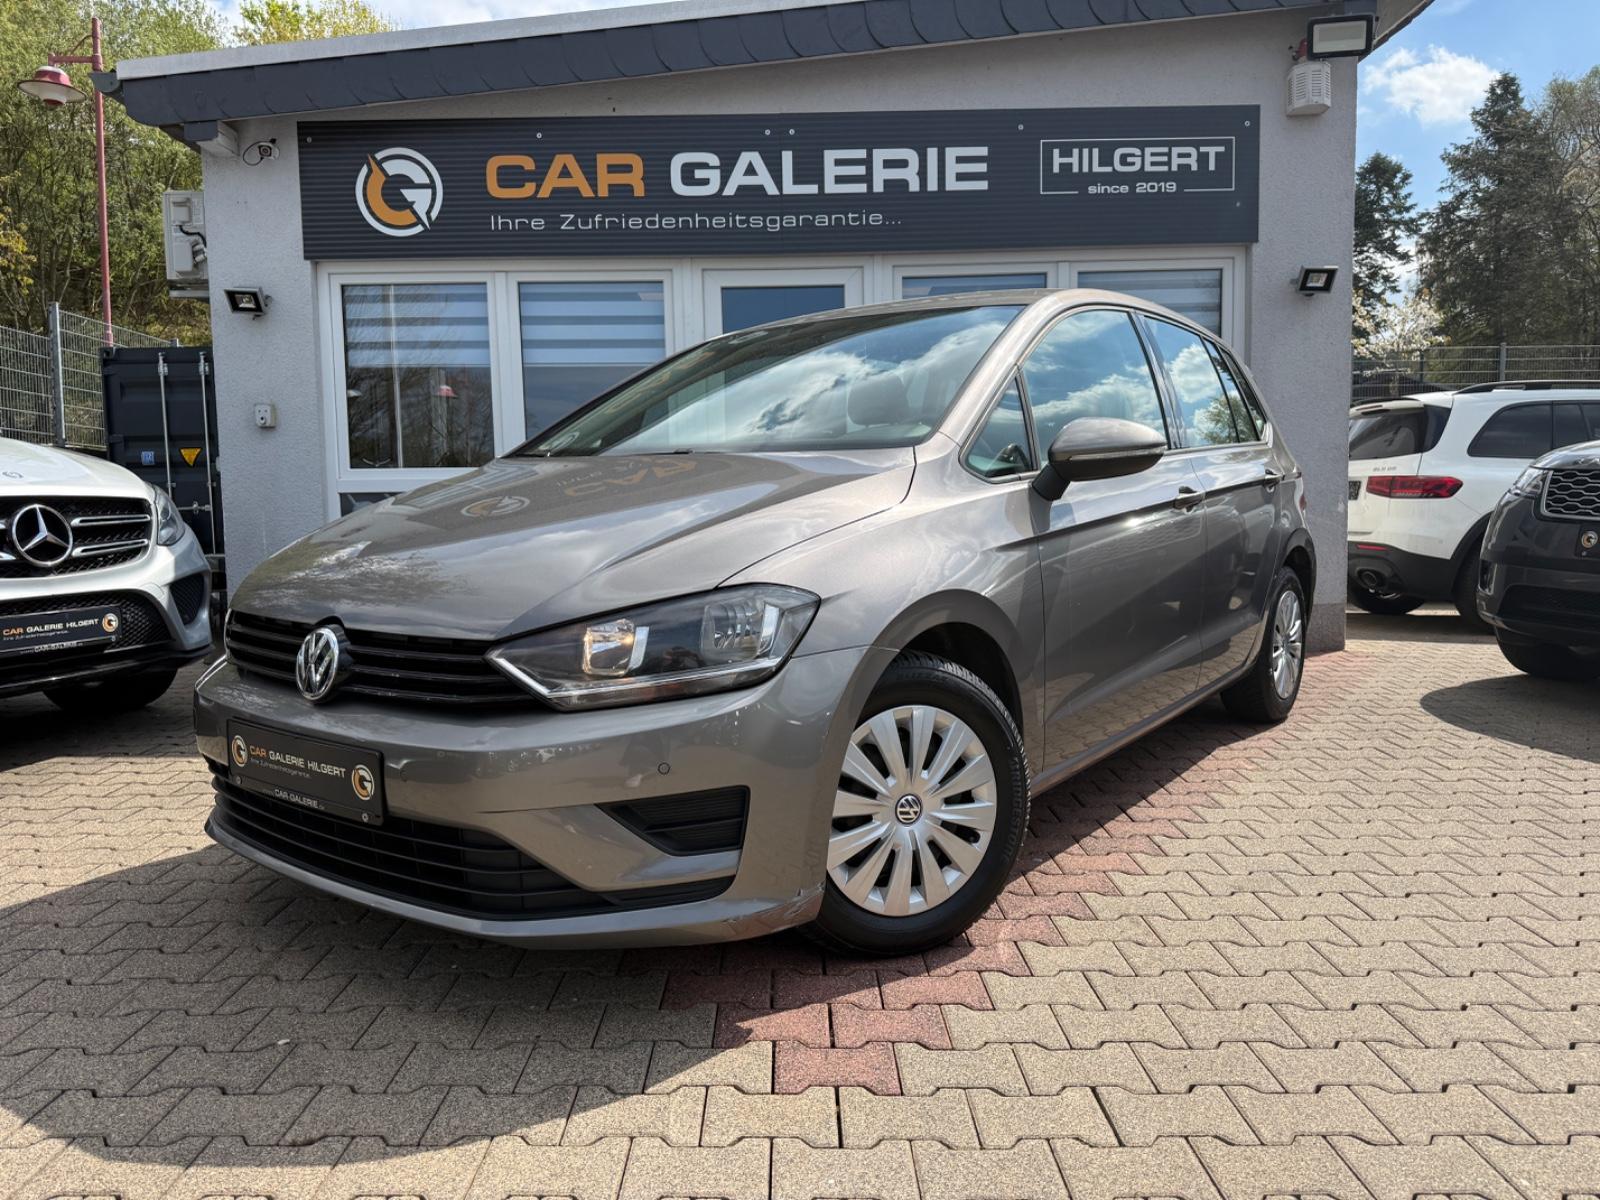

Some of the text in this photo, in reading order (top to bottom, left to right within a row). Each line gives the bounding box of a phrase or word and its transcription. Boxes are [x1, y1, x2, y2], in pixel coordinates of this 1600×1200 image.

[485, 146, 988, 199] CAR GALERIE
[1052, 146, 1225, 174] HILGERT
[1087, 181, 1177, 194] since 2019
[491, 209, 901, 232] Ihre Zufriedenheitsgarantie...
[2, 627, 24, 636] CAR
[26, 623, 64, 633] GALERIE
[250, 745, 267, 758] CAR
[269, 750, 305, 768] GALERIE
[307, 760, 346, 778] HILGERT
